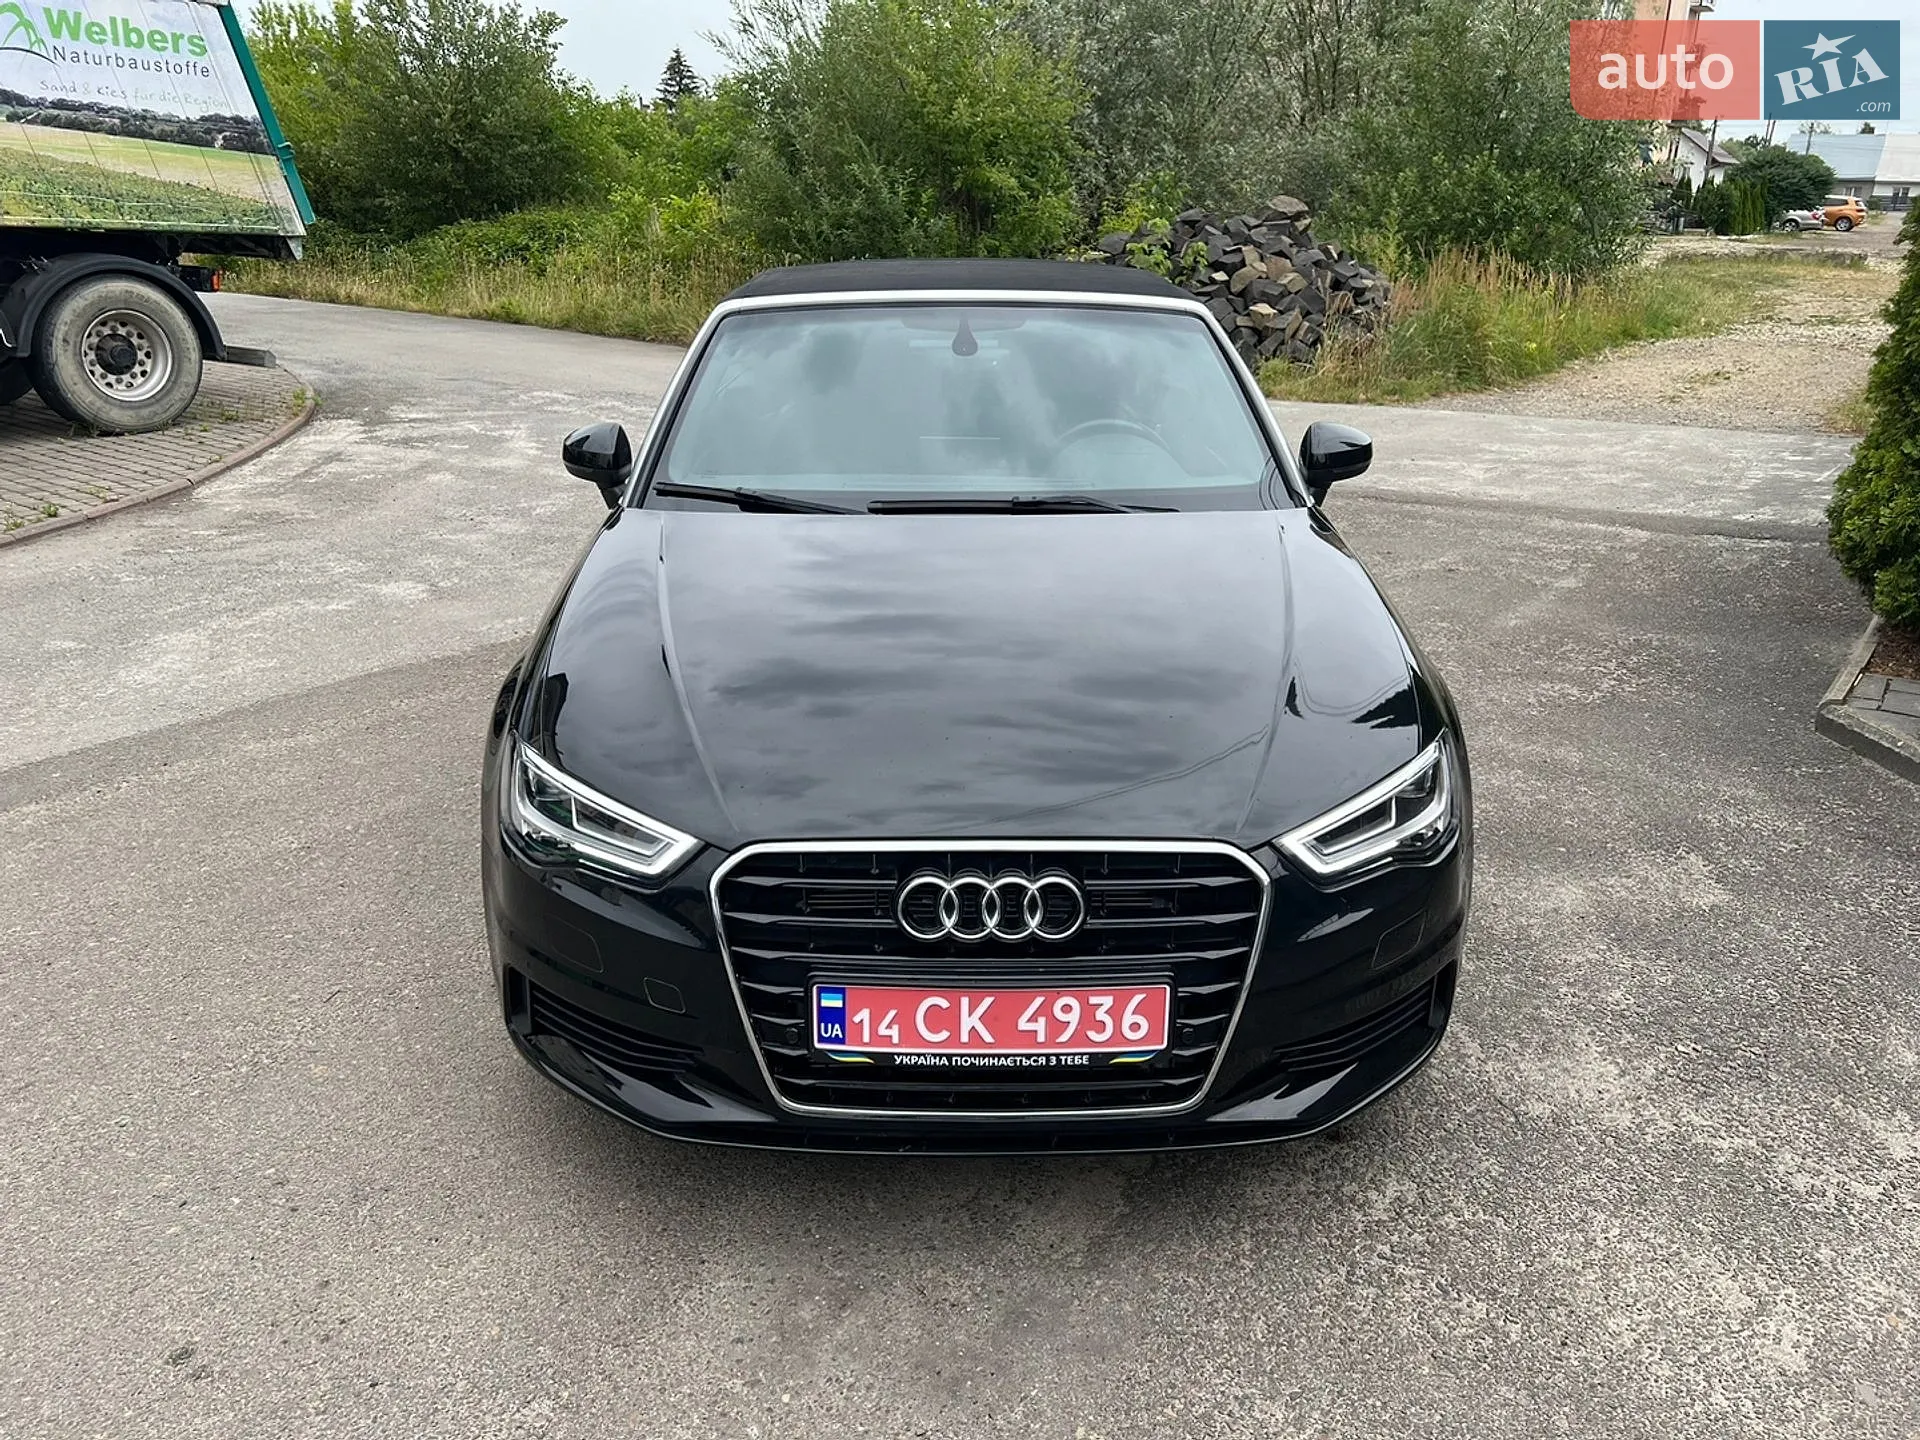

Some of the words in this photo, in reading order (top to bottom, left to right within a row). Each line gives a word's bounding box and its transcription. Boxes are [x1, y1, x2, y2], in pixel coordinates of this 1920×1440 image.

[43, 7, 208, 57] Welbers
[53, 46, 210, 77] Naturbaustoffe
[40, 80, 77, 96] Sand
[851, 1008, 900, 1044] 14
[1016, 993, 1150, 1044] 4936
[820, 1023, 843, 1039] UA
[894, 1054, 949, 1066] УКРАЇНА
[952, 1055, 1046, 1067] ПОЧИНАЄТЬСЯ
[1059, 1055, 1090, 1065] ТЕБЕ
